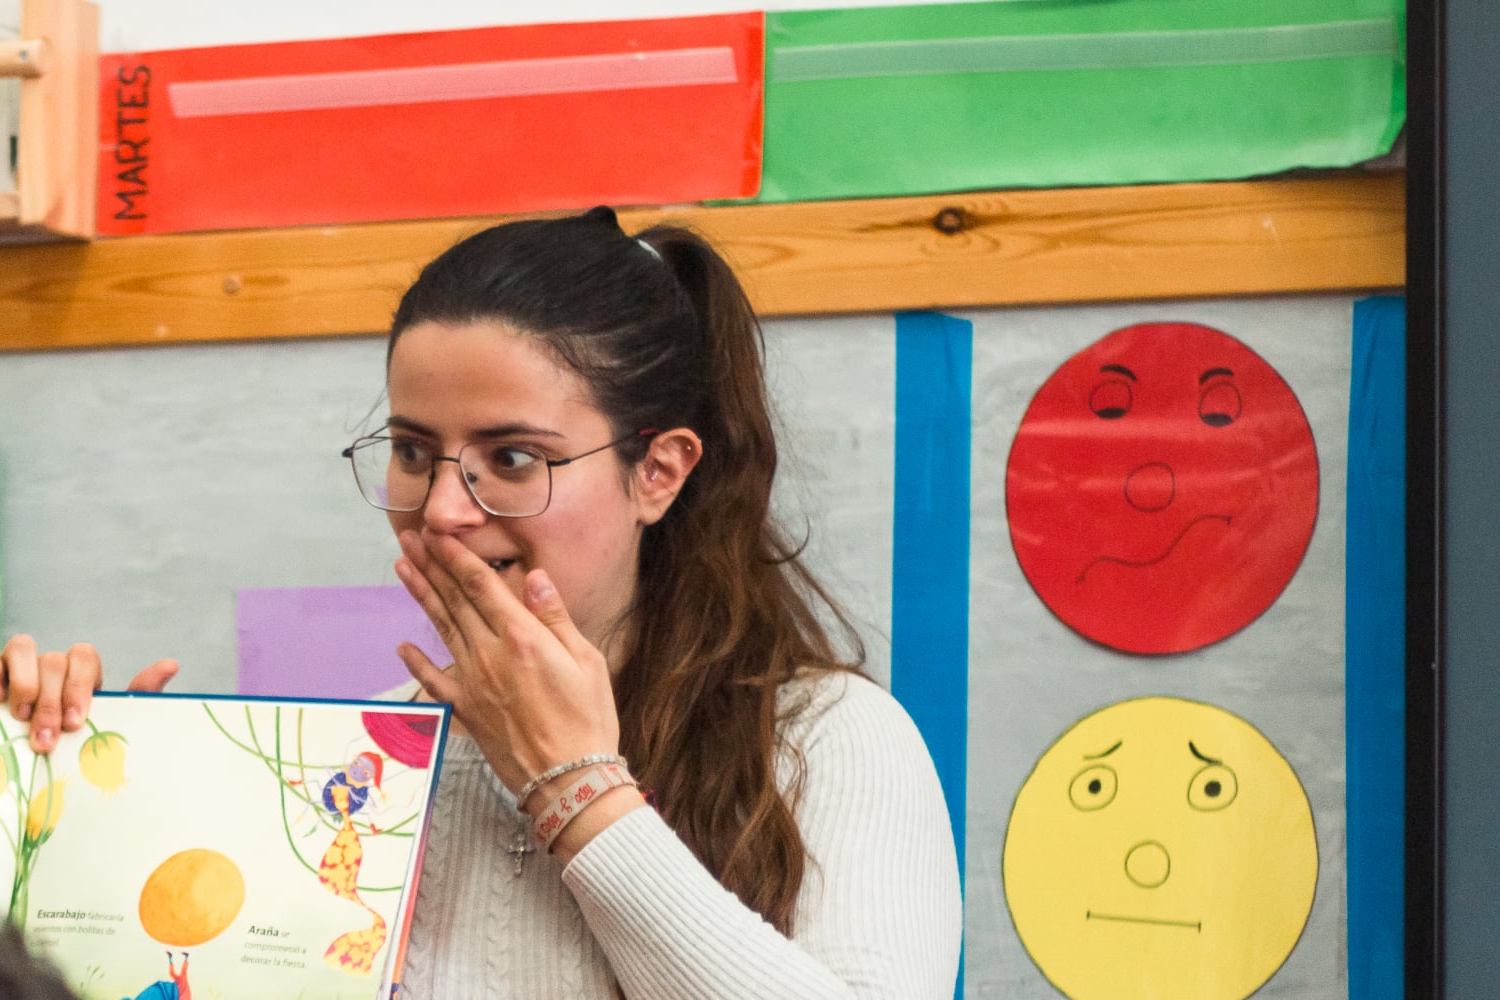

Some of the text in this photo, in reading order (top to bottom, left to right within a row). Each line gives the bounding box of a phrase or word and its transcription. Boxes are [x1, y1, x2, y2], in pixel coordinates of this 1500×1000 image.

[114, 65, 150, 220] MARTES
[37, 909, 86, 920] Escarabajo
[248, 925, 279, 937] Araña
